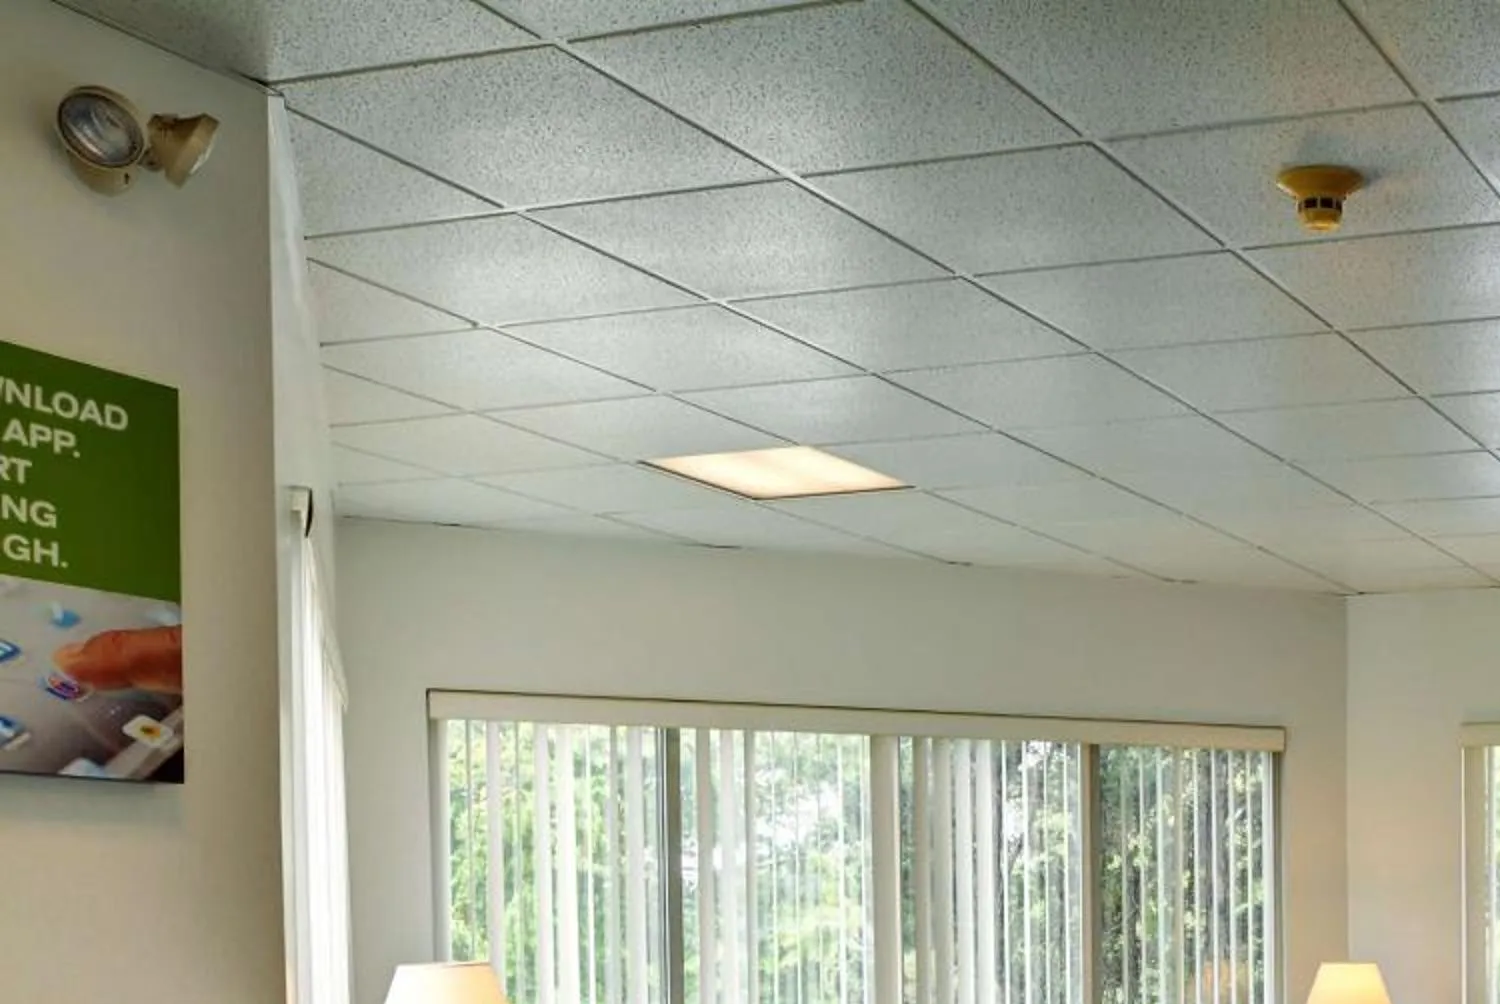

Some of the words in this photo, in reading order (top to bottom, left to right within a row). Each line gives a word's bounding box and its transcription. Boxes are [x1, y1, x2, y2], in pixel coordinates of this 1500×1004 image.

[0, 376, 129, 431] NLOAD
[2, 418, 81, 458] APP.
[0, 493, 57, 528] NG
[2, 533, 69, 568] GH.
